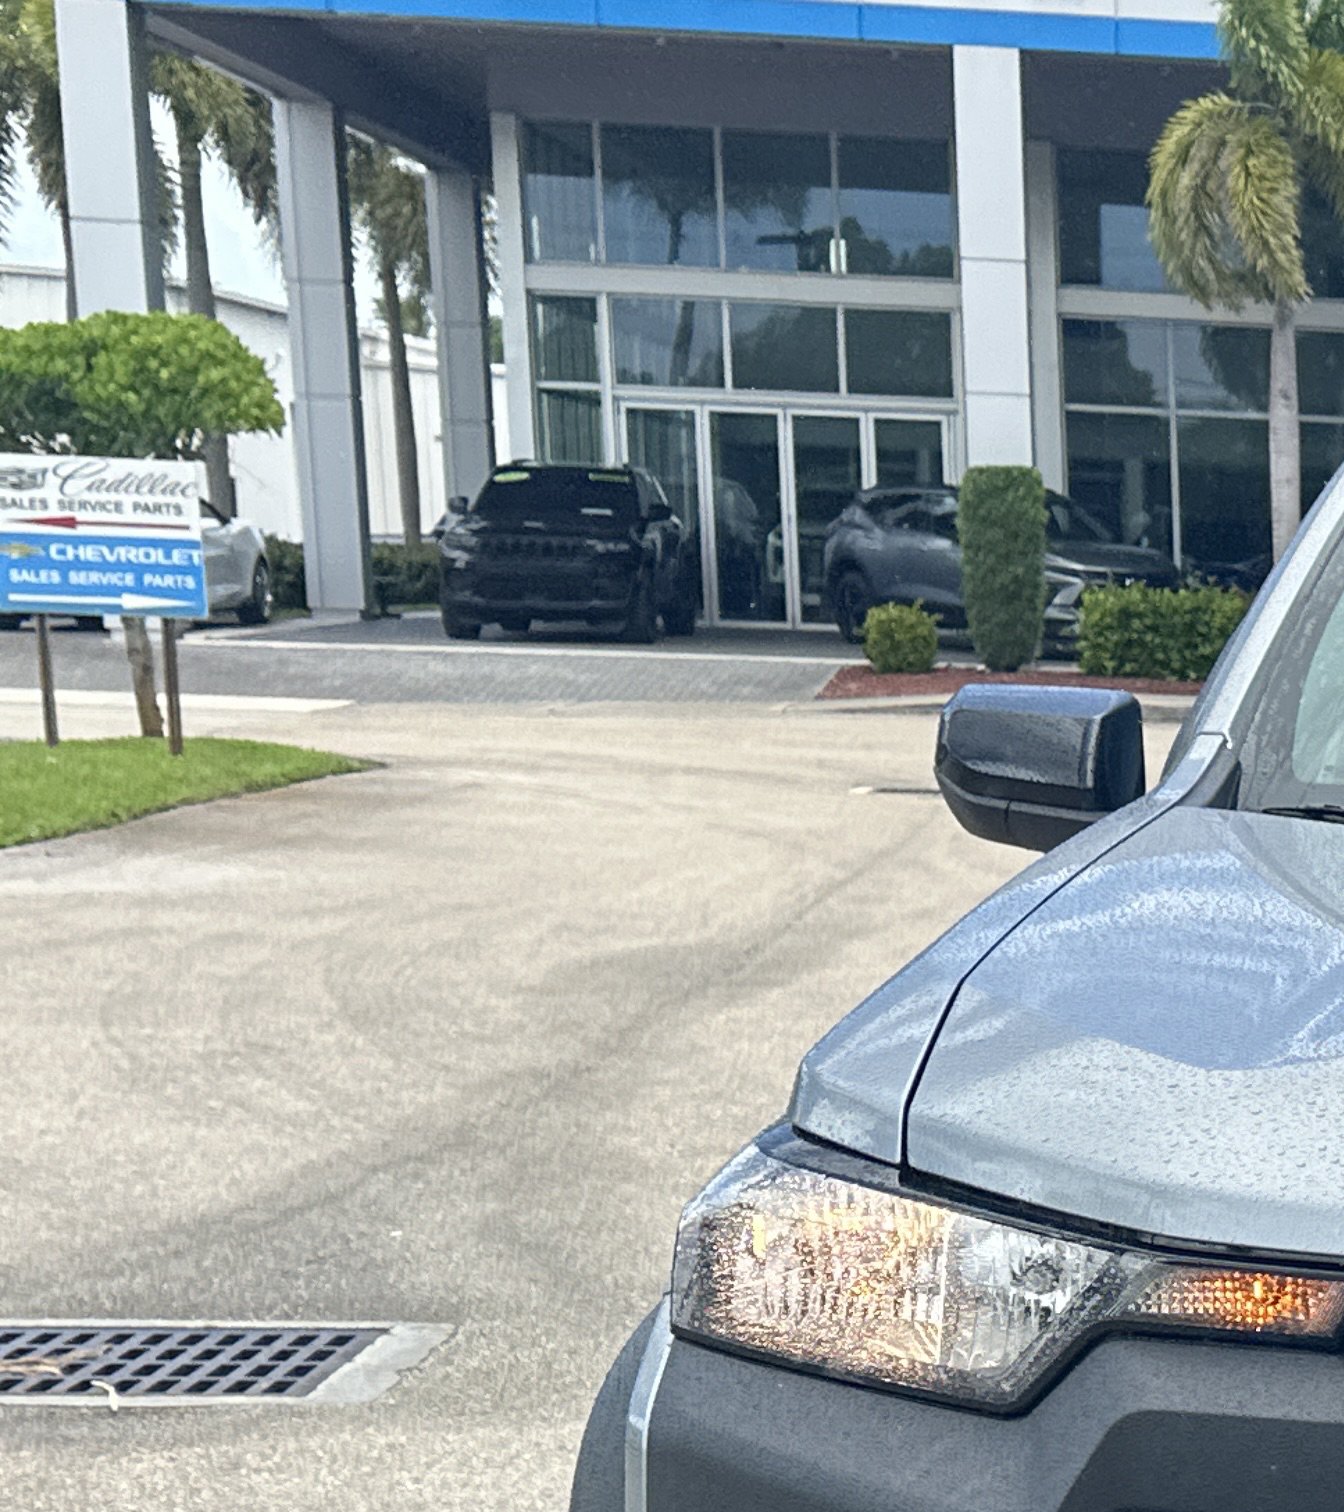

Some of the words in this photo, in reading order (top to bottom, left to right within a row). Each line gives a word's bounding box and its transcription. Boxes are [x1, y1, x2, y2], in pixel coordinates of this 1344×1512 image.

[52, 460, 198, 499] Cadillac
[0, 496, 49, 511] SALES
[58, 499, 124, 513] SERVICE
[132, 501, 183, 516] PARTS
[49, 543, 202, 566] CHEVROLET
[9, 568, 61, 584] SALES
[69, 572, 135, 587] SERVICE
[143, 574, 196, 589] PARTS
